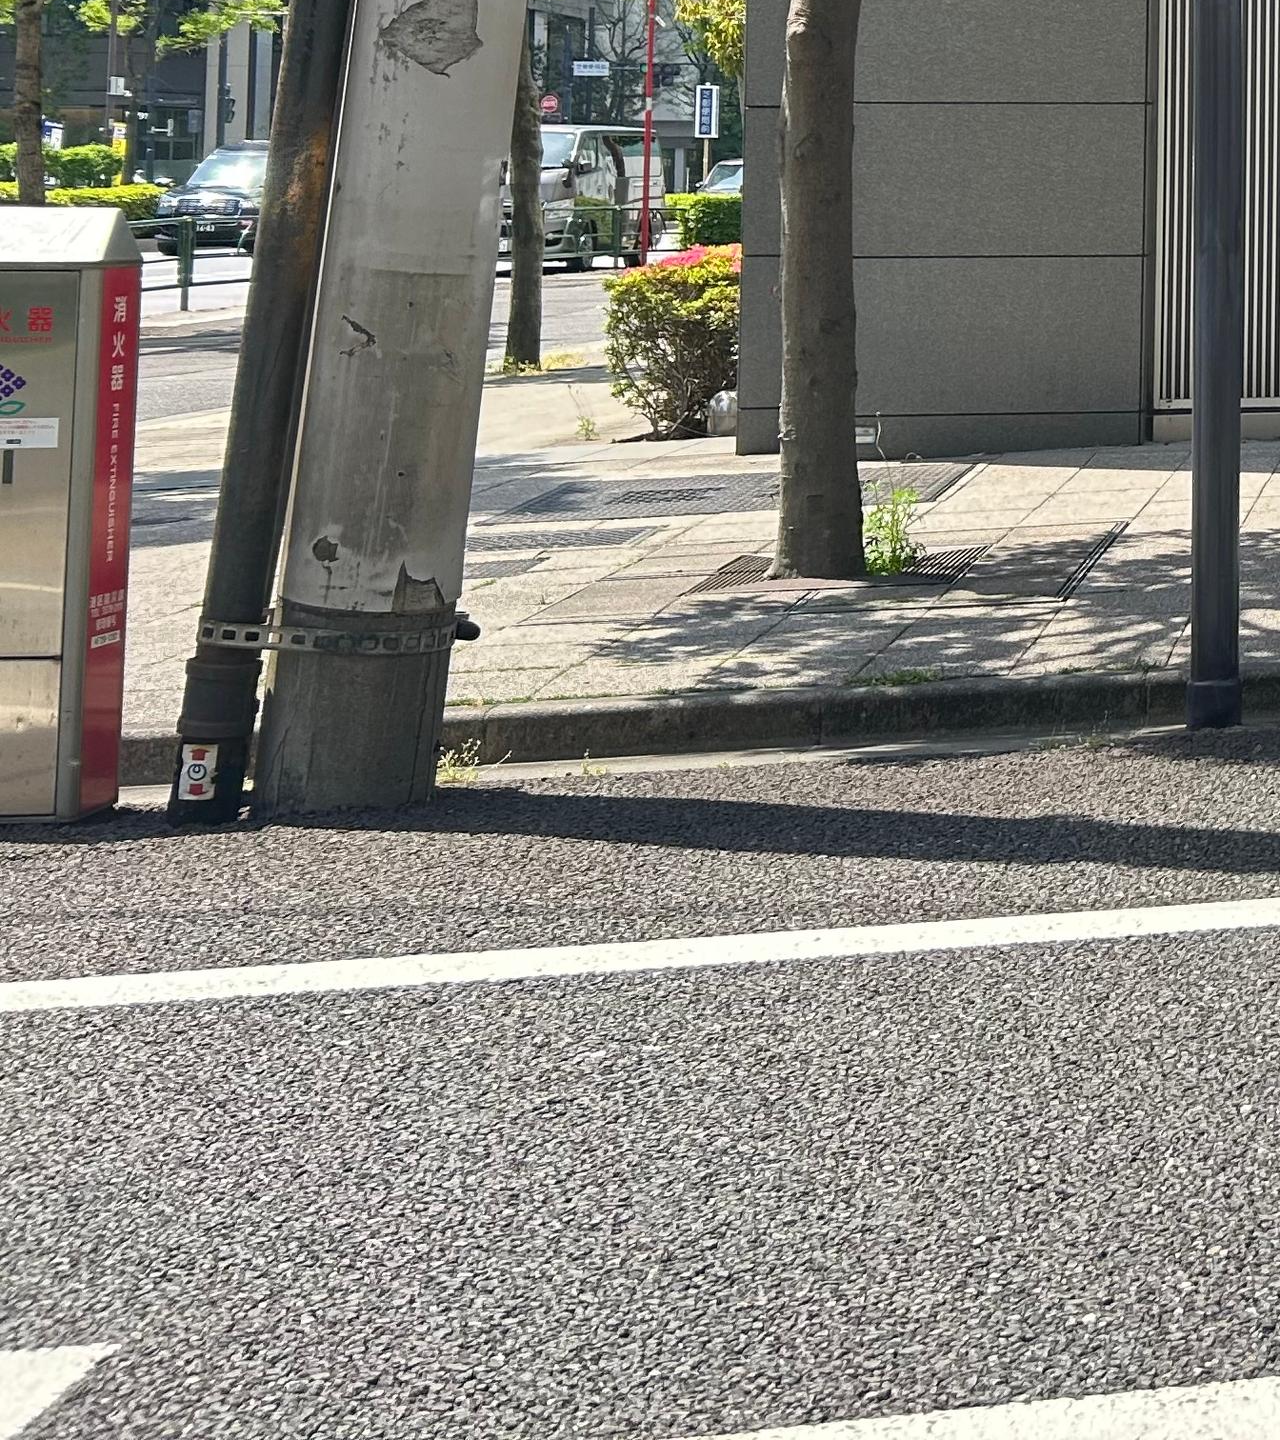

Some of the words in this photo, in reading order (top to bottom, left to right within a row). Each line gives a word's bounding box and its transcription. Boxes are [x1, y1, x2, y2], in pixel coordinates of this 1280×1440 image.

[111, 296, 127, 391] 消火器
[105, 444, 119, 563] EXTINGUISHER
